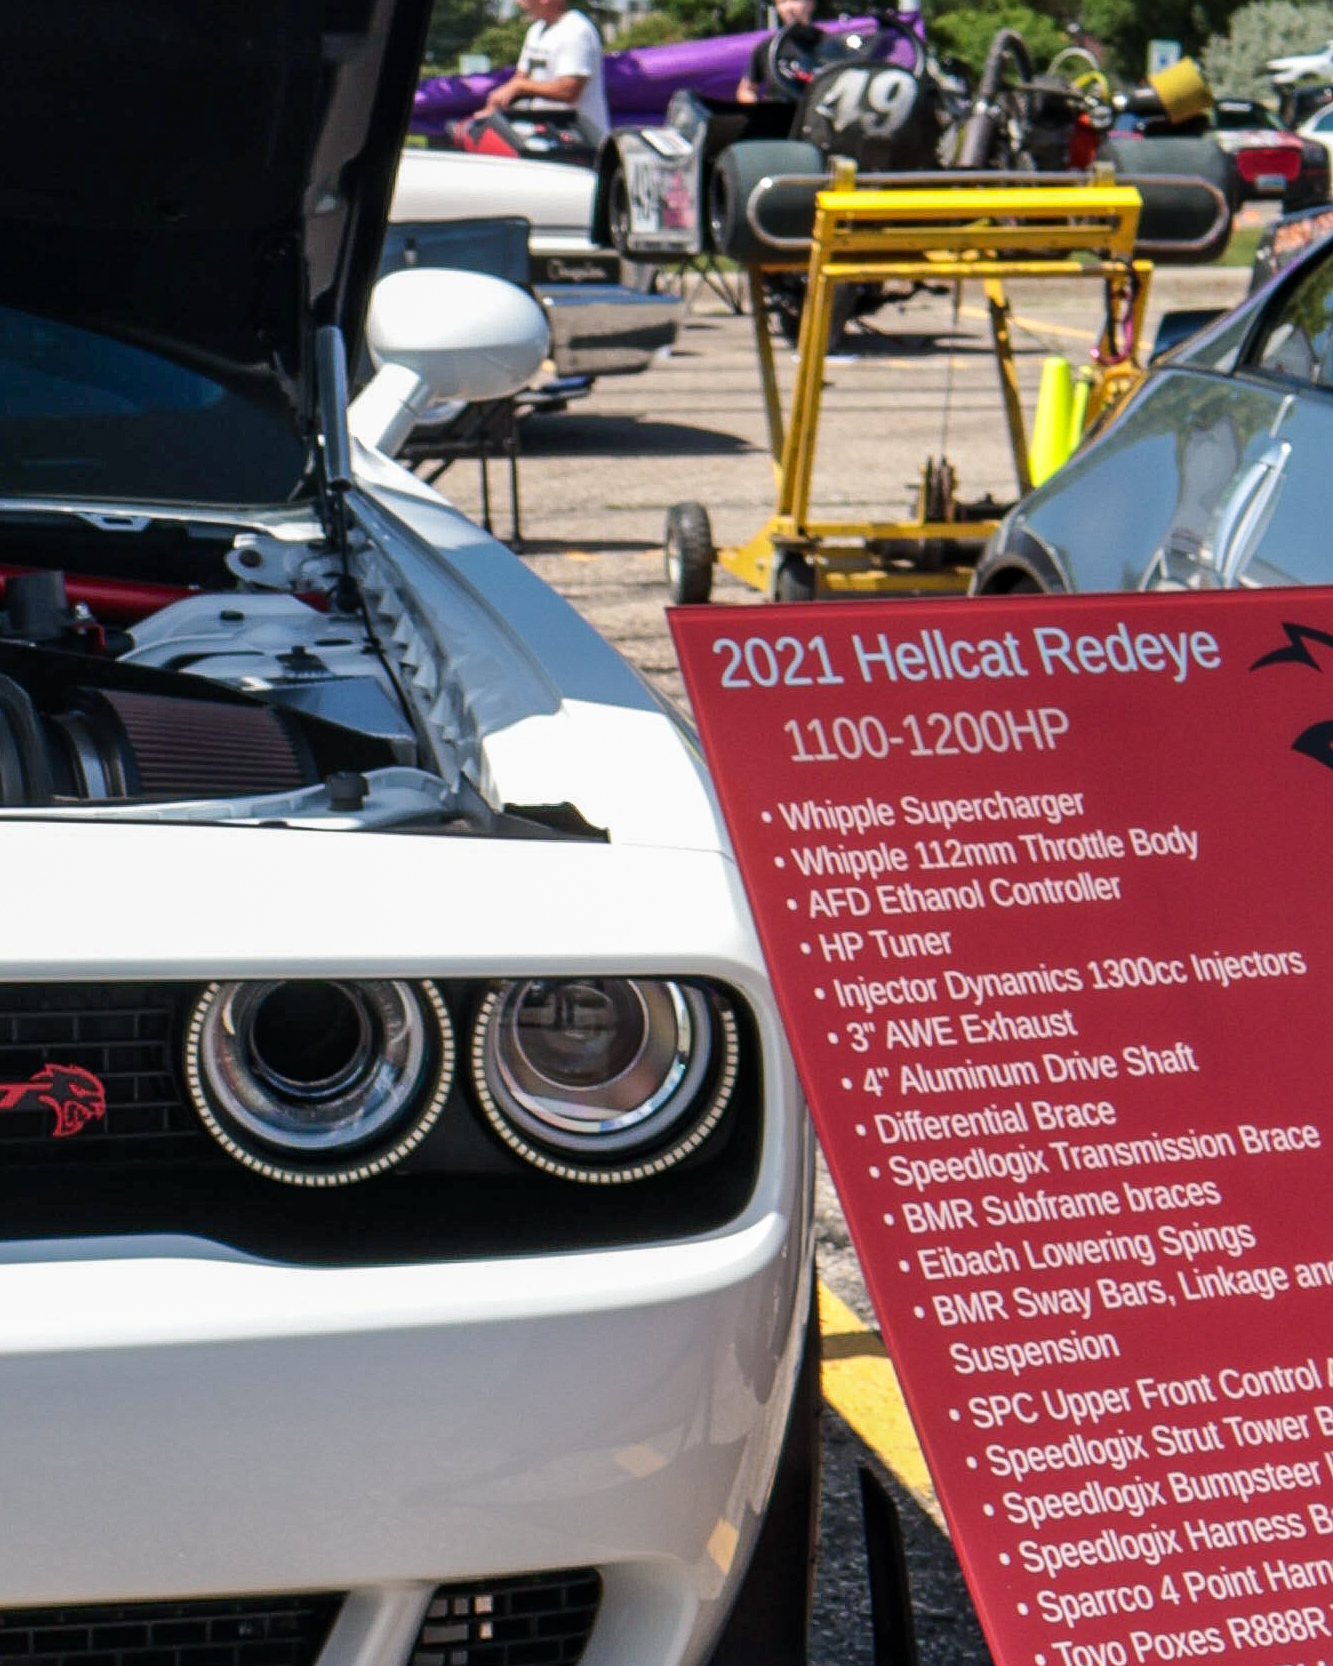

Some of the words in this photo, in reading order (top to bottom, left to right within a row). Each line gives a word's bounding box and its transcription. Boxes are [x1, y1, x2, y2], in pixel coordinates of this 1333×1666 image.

[815, 69, 917, 137] 49
[713, 636, 843, 687] 2021
[852, 630, 1028, 682] Hellcat
[1034, 623, 1220, 682] Redeye
[785, 709, 1068, 761] 1100-1200HP
[778, 797, 895, 835] Whipple
[901, 791, 1083, 829] Supercharger
[791, 842, 908, 880] Whipple
[915, 839, 1017, 869] 112mm
[1018, 830, 1125, 862] Throttle
[1129, 825, 1197, 860] Body
[810, 887, 871, 918] AFD
[876, 879, 985, 914] Ethanol
[990, 872, 1120, 907] Controller
[819, 932, 863, 962] HP
[868, 930, 951, 958] Tuner
[833, 976, 937, 1013] Injector
[944, 964, 1083, 1005] Dynamics
[1088, 957, 1187, 989] 1300cc
[1190, 951, 1306, 987] Injectors
[887, 1016, 957, 1049] AWE
[960, 1010, 1078, 1043] Exhaust
[901, 1059, 1039, 1095] Aluminum
[1042, 1051, 1118, 1082] Drive
[1123, 1042, 1199, 1076] Shaft
[874, 1102, 1028, 1149] Differential
[1032, 1101, 1116, 1130] Brace
[889, 1144, 1049, 1192] Speedlogix
[1049, 1129, 1236, 1170] Transmission
[1238, 1125, 1321, 1153] Brace
[902, 1199, 978, 1233] BMR
[982, 1190, 1120, 1225] Subframe
[1123, 1181, 1221, 1212] braces
[917, 1242, 1020, 1279] Eibach
[1023, 1231, 1156, 1269] Lowering
[1158, 1222, 1256, 1261] Spings
[932, 1290, 1009, 1326] BMR
[1013, 1287, 1091, 1319] Sway
[1097, 1278, 1176, 1309] Bars,
[1177, 1266, 1289, 1300] Linkage
[950, 1330, 1120, 1376] Suspension
[968, 1392, 1038, 1428] SPC
[1042, 1387, 1131, 1425] Upper
[1136, 1374, 1217, 1409] Front
[1219, 1359, 1322, 1399] Control
[986, 1429, 1149, 1482] Speedlogix
[1151, 1422, 1224, 1456] Strut
[1222, 1415, 1309, 1446] Tower
[1003, 1476, 1167, 1530] Speedlogix
[1167, 1461, 1321, 1503] Bumpsteer
[1019, 1523, 1183, 1578] Speedlogix
[1184, 1513, 1306, 1551] Harness
[1308, 1504, 1333, 1534] B
[1037, 1585, 1153, 1628] Sparrco
[1161, 1575, 1180, 1605] 4
[1183, 1566, 1263, 1602] Point
[1130, 1627, 1225, 1663] Poxes
[1226, 1604, 1332, 1649] R888R
